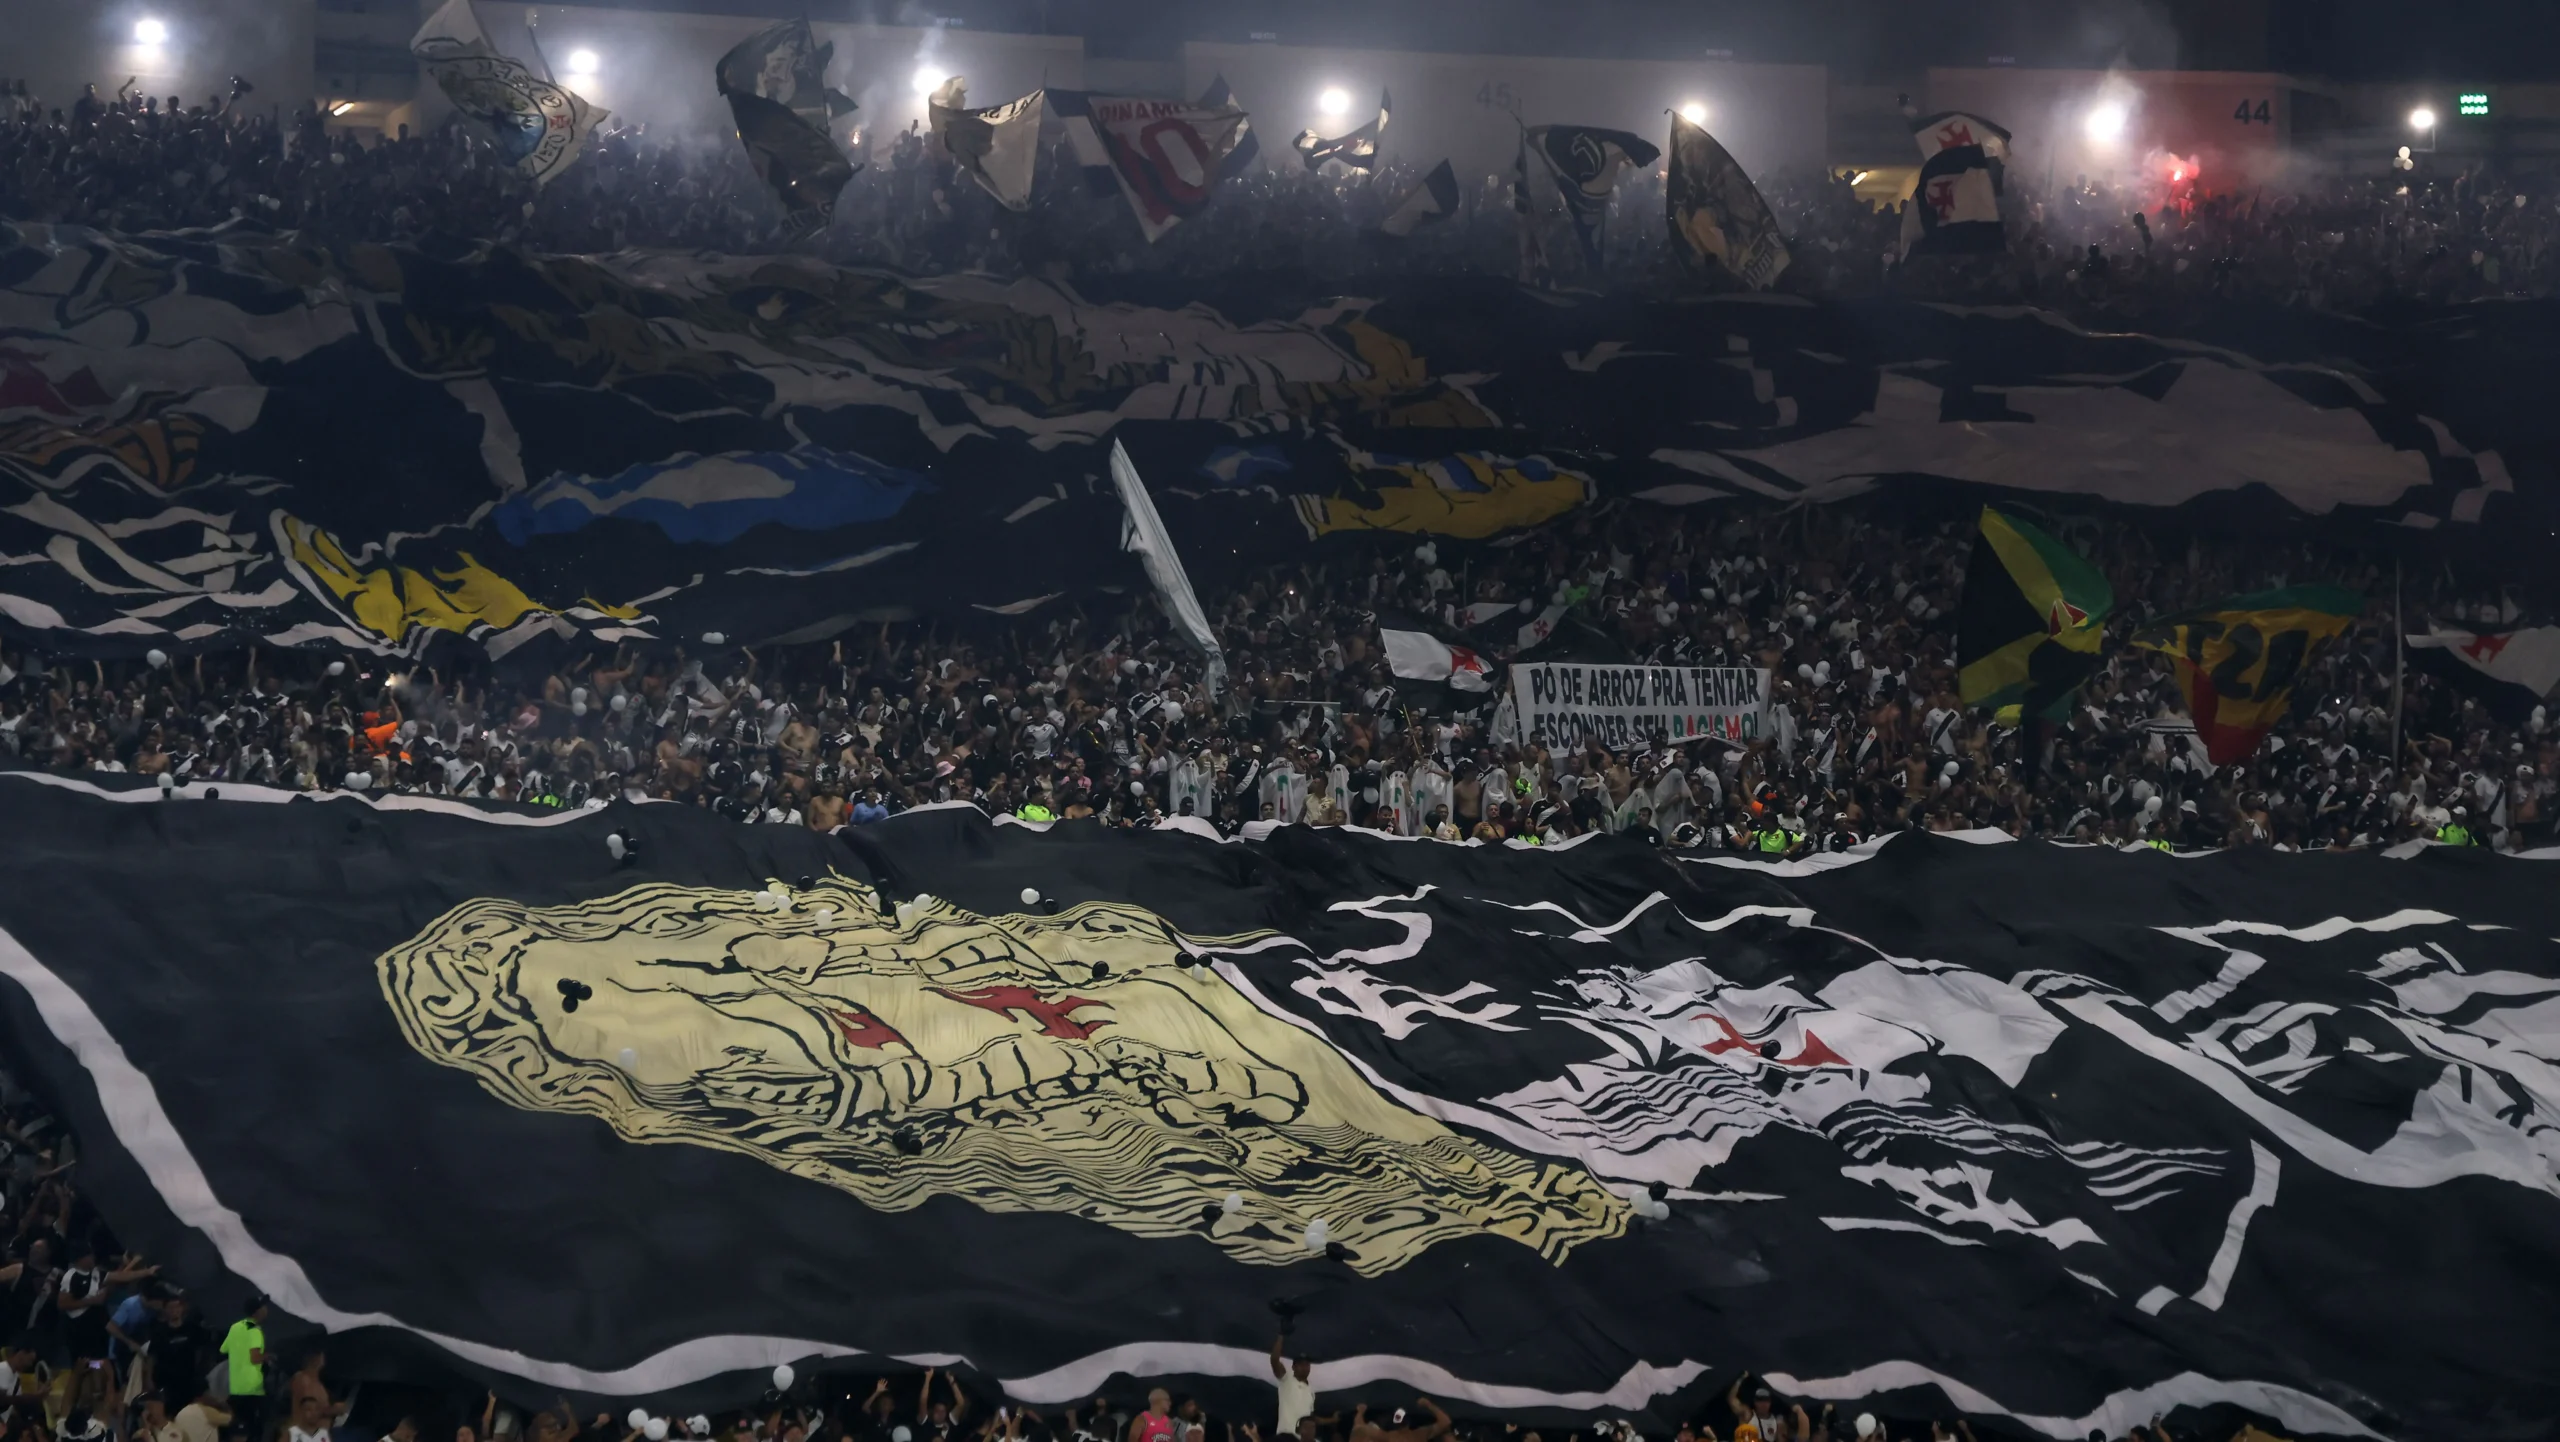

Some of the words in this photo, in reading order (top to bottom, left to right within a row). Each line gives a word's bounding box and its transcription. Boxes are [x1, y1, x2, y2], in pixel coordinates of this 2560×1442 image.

[1476, 79, 1511, 111] 45
[2233, 99, 2272, 124] 44
[1560, 667, 1583, 706] DE
[1588, 668, 1647, 707] ARROZ
[1651, 668, 1688, 707] PRA
[1690, 668, 1761, 707] TENTAR
[1533, 711, 1629, 749] ESCONDER
